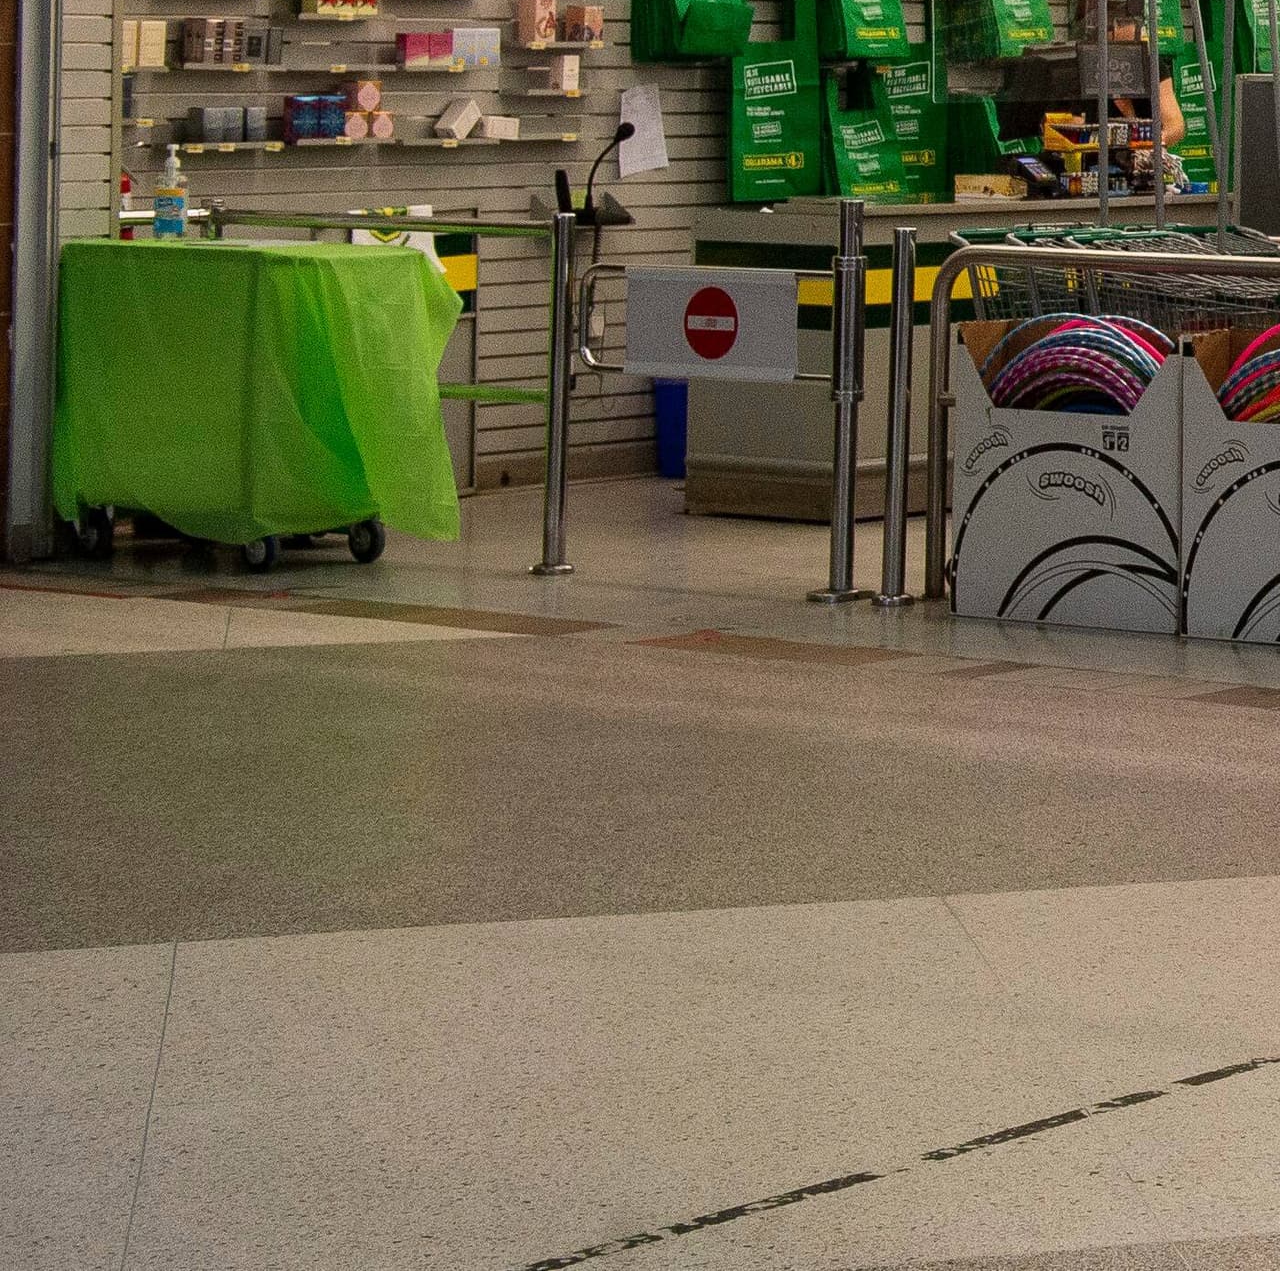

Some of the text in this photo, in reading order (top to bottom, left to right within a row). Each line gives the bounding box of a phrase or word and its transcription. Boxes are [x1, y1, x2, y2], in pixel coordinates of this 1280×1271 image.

[965, 431, 1008, 470] swoosh
[1195, 447, 1245, 487] swoosh
[1038, 471, 1106, 506] swoosh
